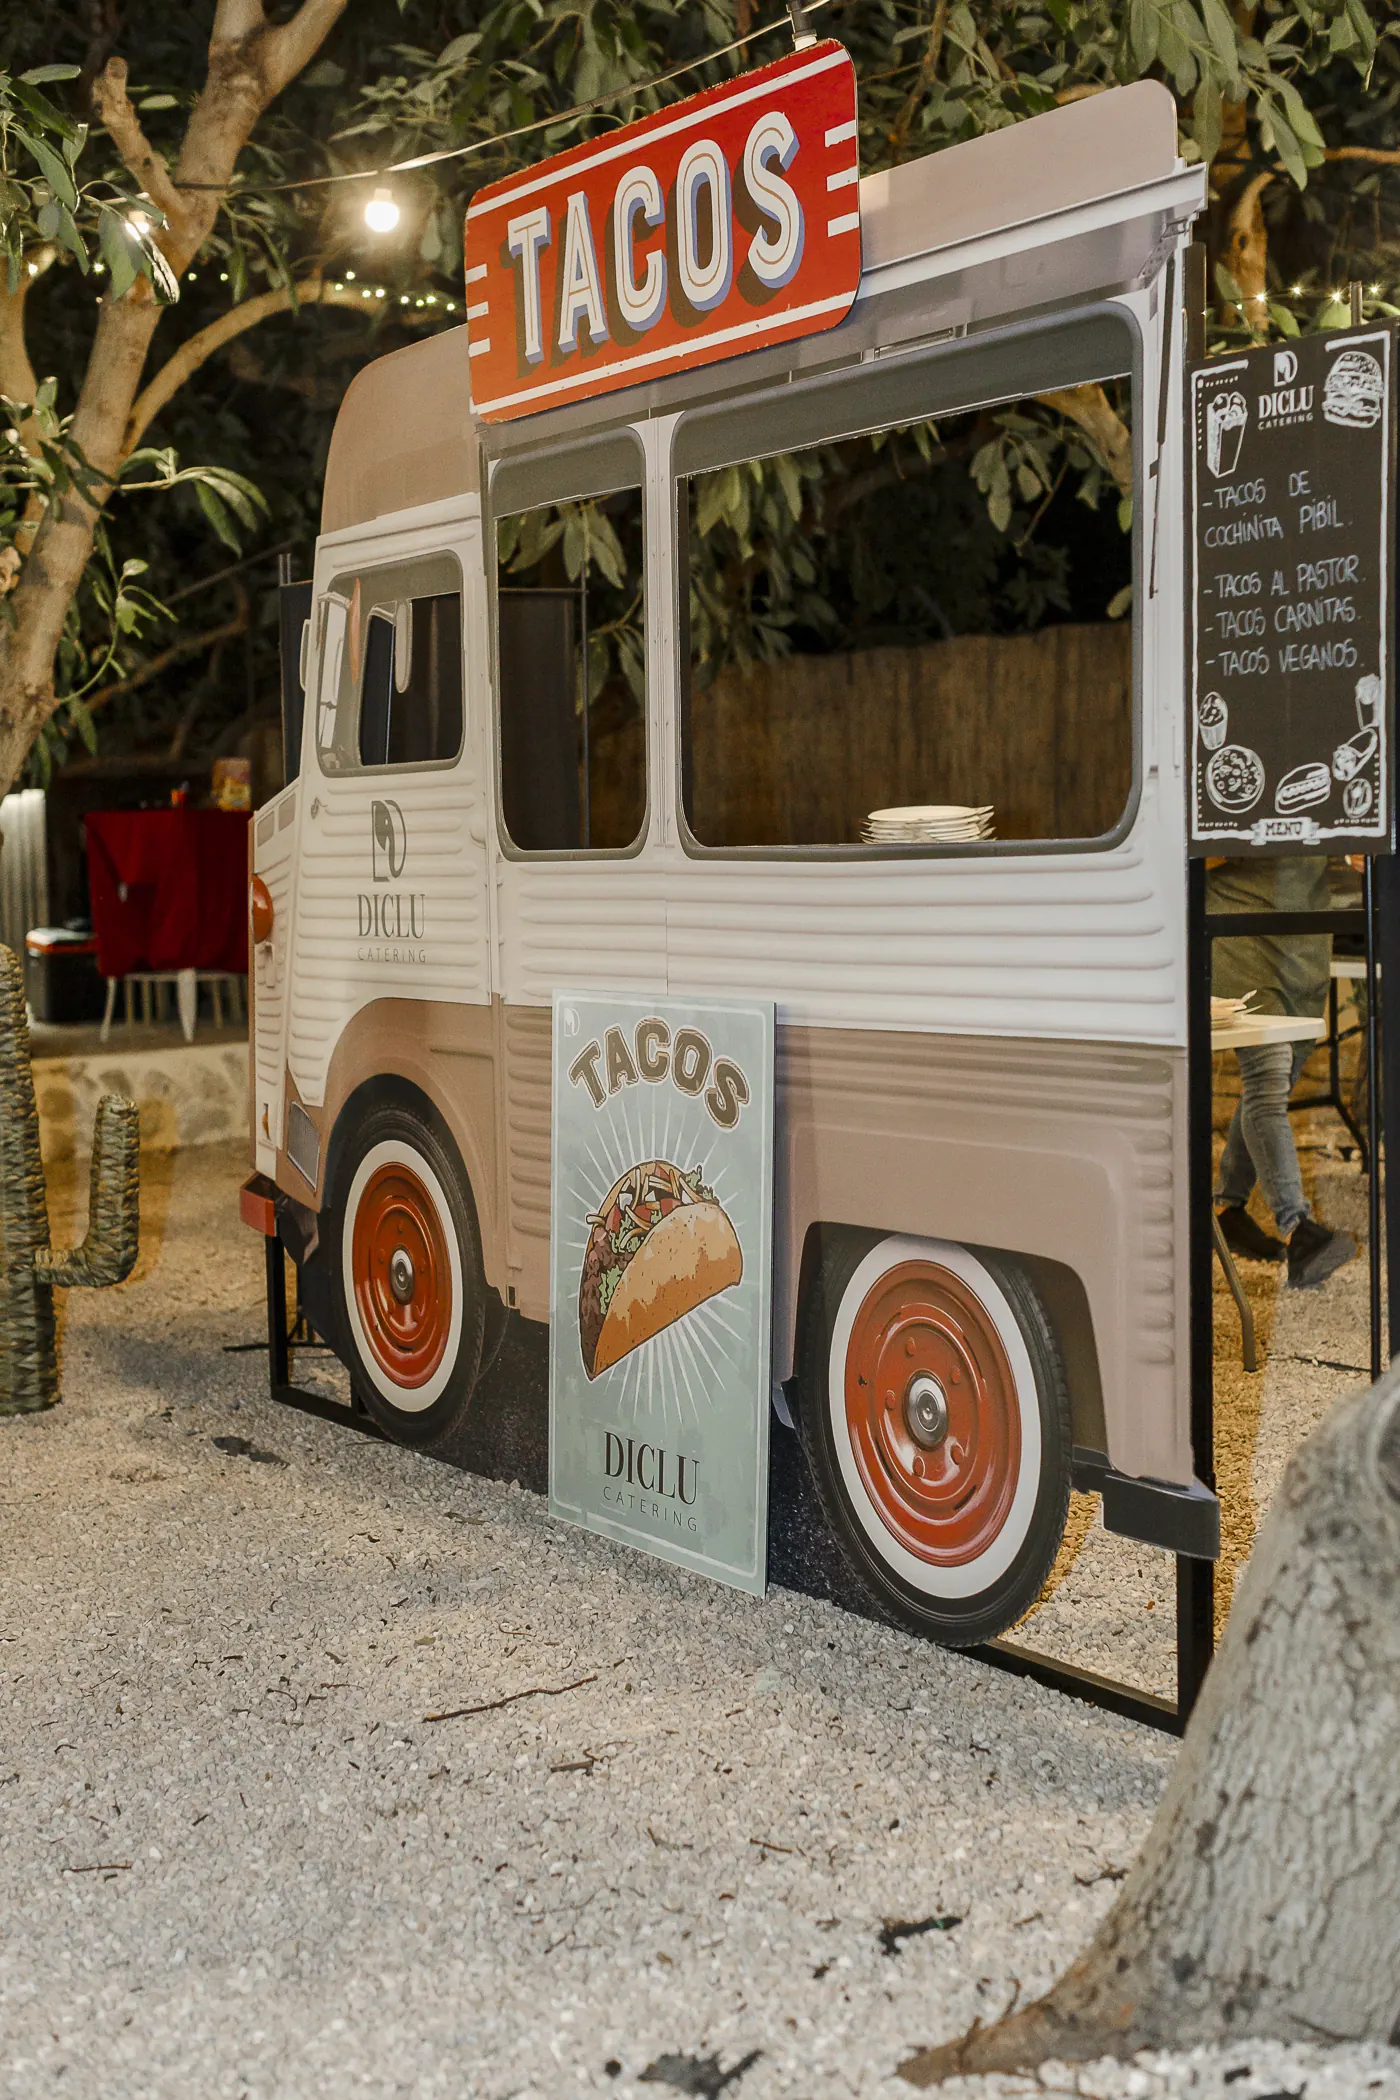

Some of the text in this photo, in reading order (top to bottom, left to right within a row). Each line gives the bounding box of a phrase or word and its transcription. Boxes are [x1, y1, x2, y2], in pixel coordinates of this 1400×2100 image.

[504, 111, 805, 370] TACOS
[1258, 385, 1315, 419] DICLU
[1257, 412, 1314, 431] CATERING
[1289, 470, 1311, 497] DE
[1270, 569, 1290, 597] AL
[1265, 820, 1303, 837] MENU
[357, 893, 425, 939] DICLU
[357, 947, 426, 963] CATERING
[568, 1016, 750, 1130] TACOS
[603, 1430, 700, 1505] DICLU
[603, 1486, 698, 1532] CATERING
